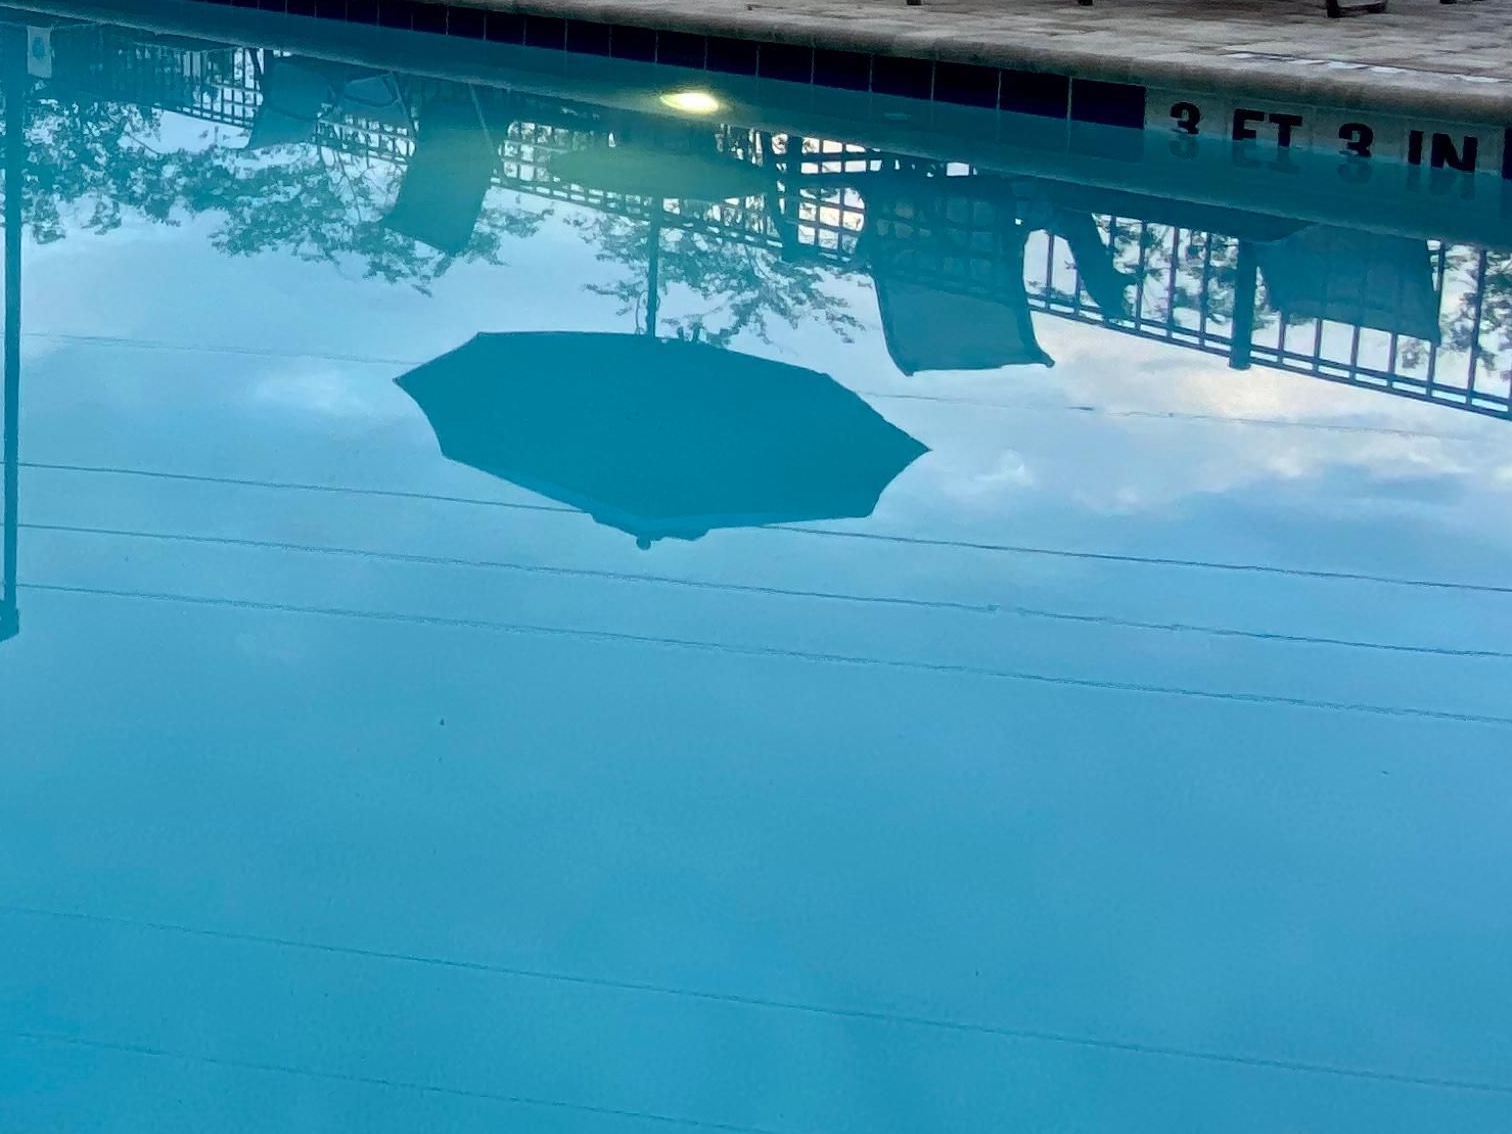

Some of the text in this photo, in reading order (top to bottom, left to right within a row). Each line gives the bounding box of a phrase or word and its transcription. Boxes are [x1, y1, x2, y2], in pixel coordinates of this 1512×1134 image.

[1170, 101, 1479, 172] 3 FT 3 IN
